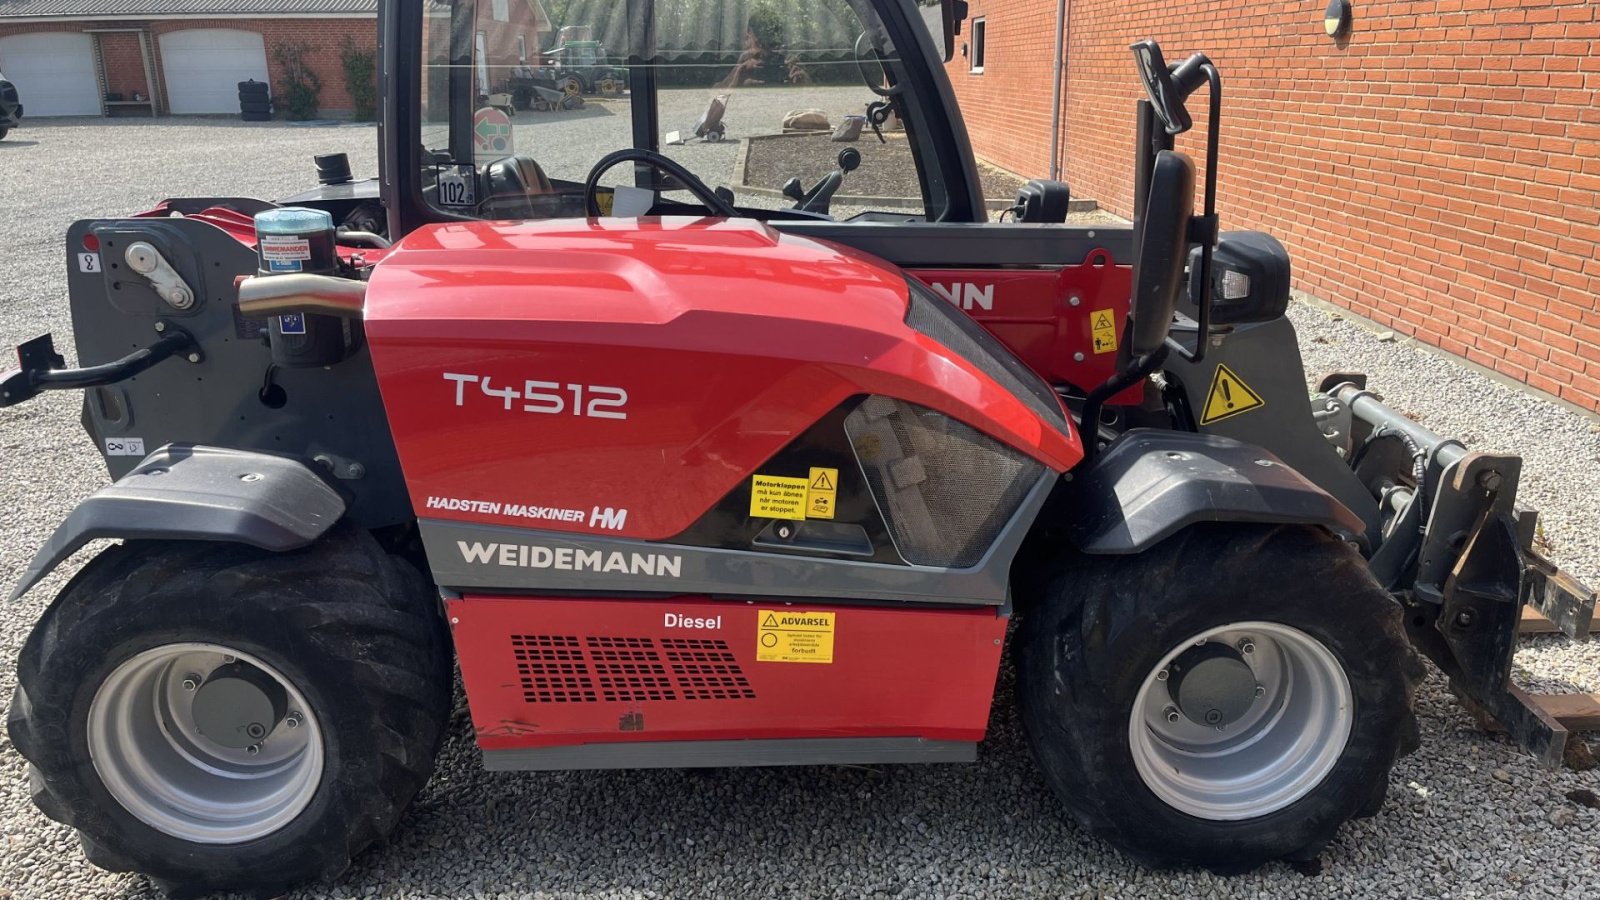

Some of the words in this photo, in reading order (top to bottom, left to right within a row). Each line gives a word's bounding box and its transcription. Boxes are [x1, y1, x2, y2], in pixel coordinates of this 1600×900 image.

[442, 182, 465, 203] 102
[443, 372, 628, 420] T4512
[756, 481, 805, 490] Motorklappen
[426, 496, 501, 515] HADSTEN
[503, 503, 585, 522] MASKINER
[589, 506, 628, 530] HM
[457, 540, 682, 577] WEIDEMANN
[664, 613, 721, 629] Diesel
[781, 617, 830, 626] ADVARSEL
